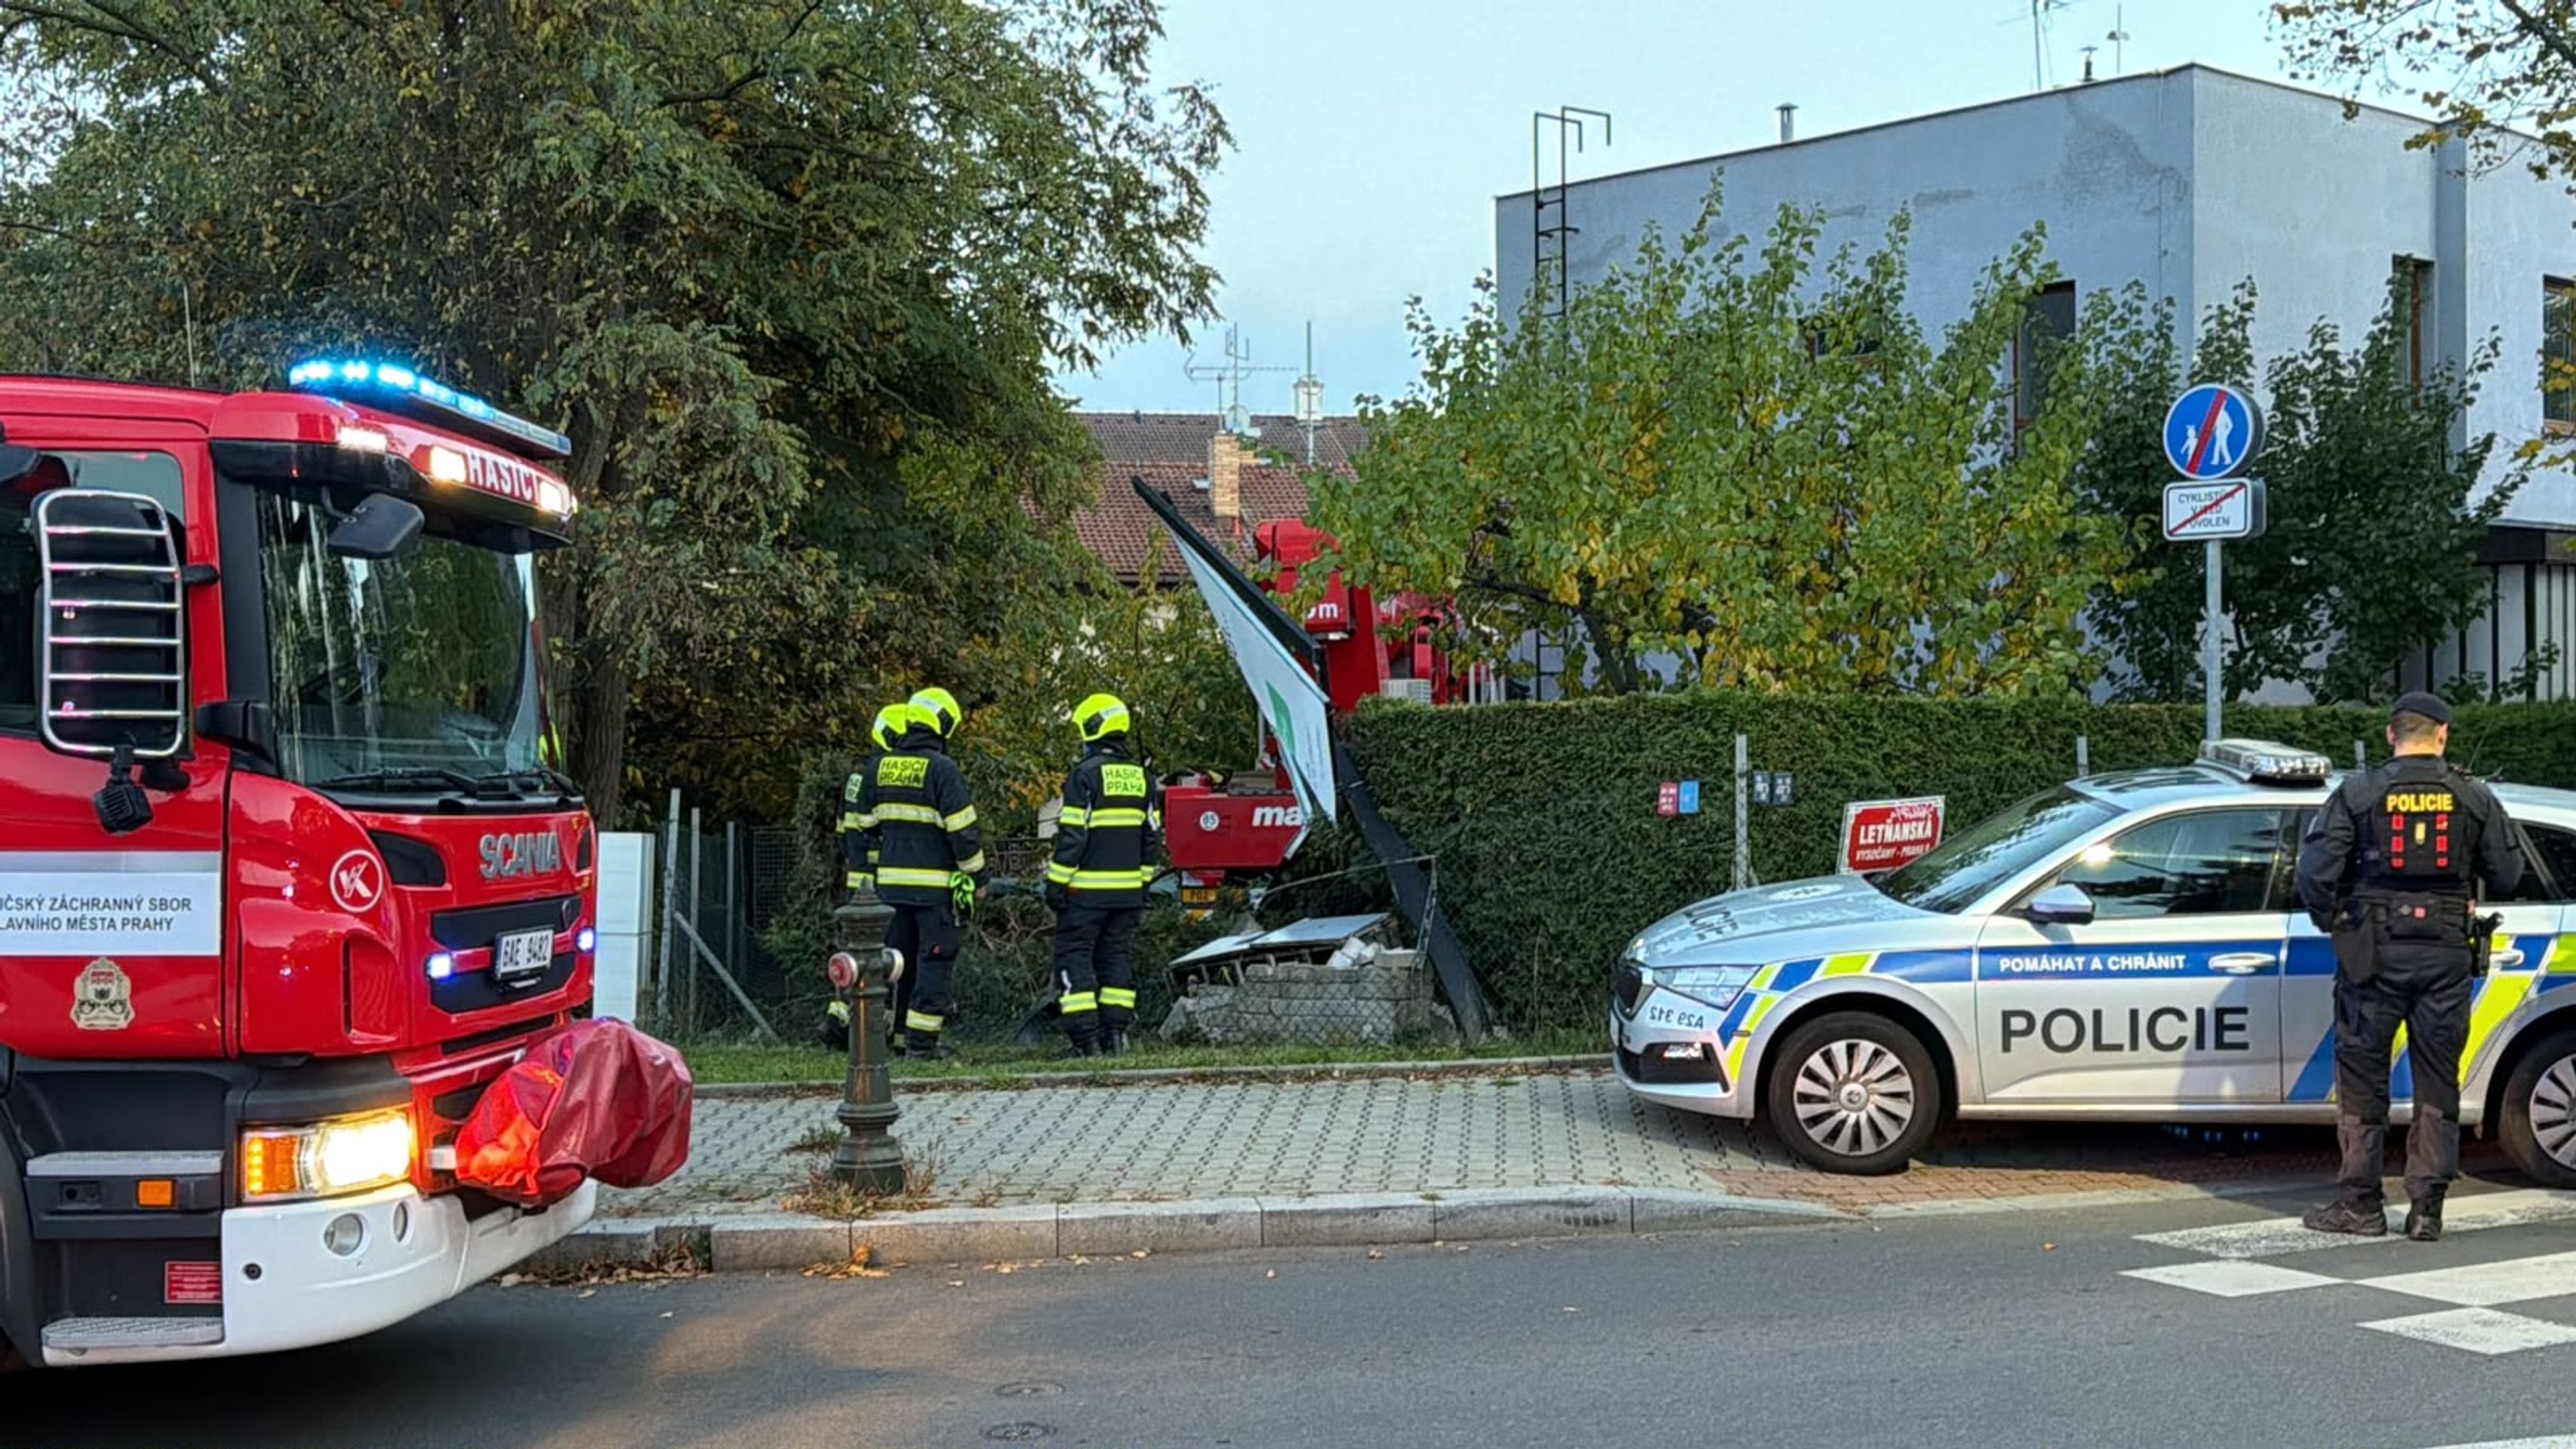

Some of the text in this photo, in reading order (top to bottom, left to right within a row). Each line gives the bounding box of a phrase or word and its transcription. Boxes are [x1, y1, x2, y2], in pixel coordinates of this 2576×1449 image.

[879, 771, 920, 785] PRAHA
[2386, 793, 2454, 813] POLICIE
[1859, 813, 1932, 845] LETŇANSKÁ
[479, 832, 562, 879] SCANIA
[1856, 846, 1896, 861] VYSOČANY
[48, 894, 144, 912] ZÁCHRANNÝ
[148, 897, 192, 912] SBOR
[66, 914, 117, 931] MĚSTA
[122, 916, 174, 931] PRAHY
[1999, 952, 2186, 973] POMÁHAT A CHRÁNIT
[2001, 1006, 2250, 1054] POLICIE
